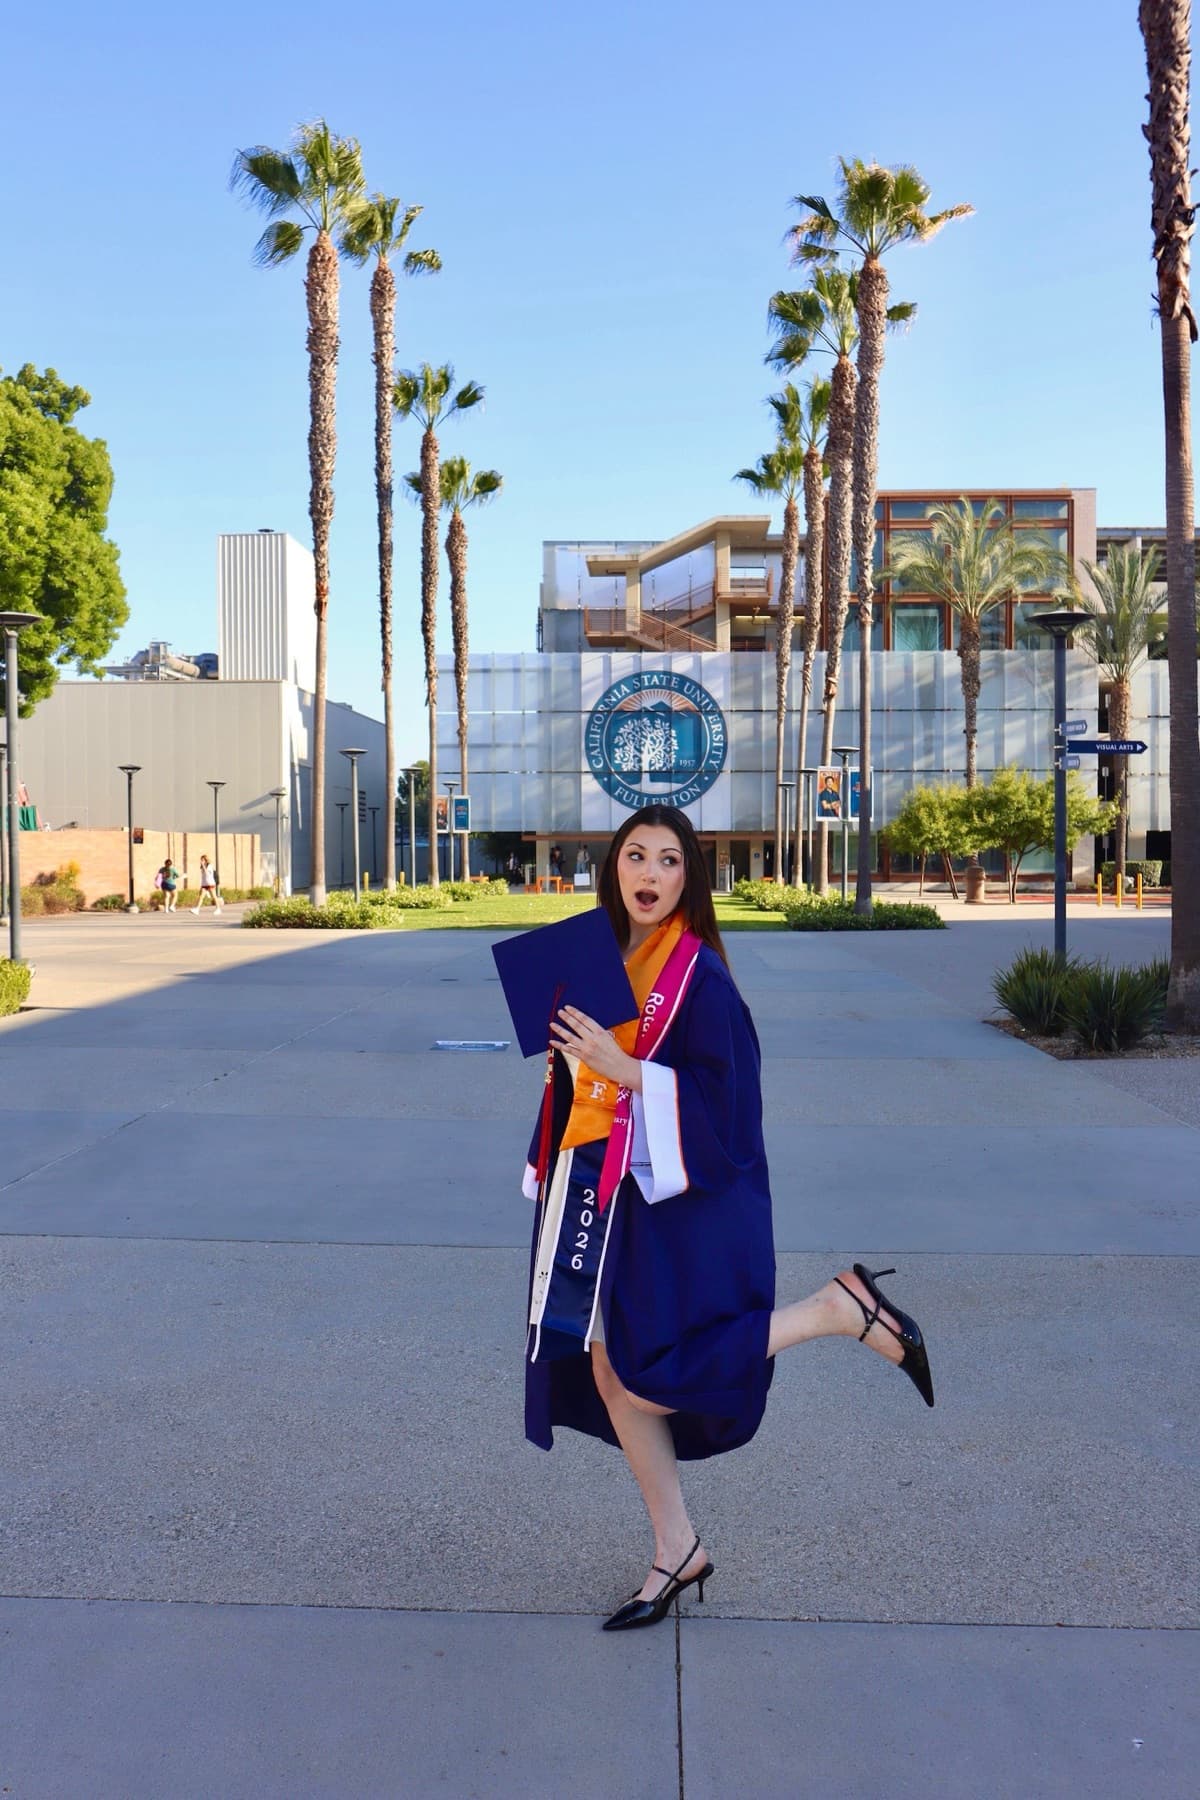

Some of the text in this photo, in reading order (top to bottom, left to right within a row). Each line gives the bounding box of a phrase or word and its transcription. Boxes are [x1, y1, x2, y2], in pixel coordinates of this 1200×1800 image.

[589, 674, 724, 774] CALIFORNIA STATE UNIVERSITY
[679, 759, 696, 767] 1957
[613, 783, 702, 808] FULLERTON
[571, 1189, 595, 1270] 2026
